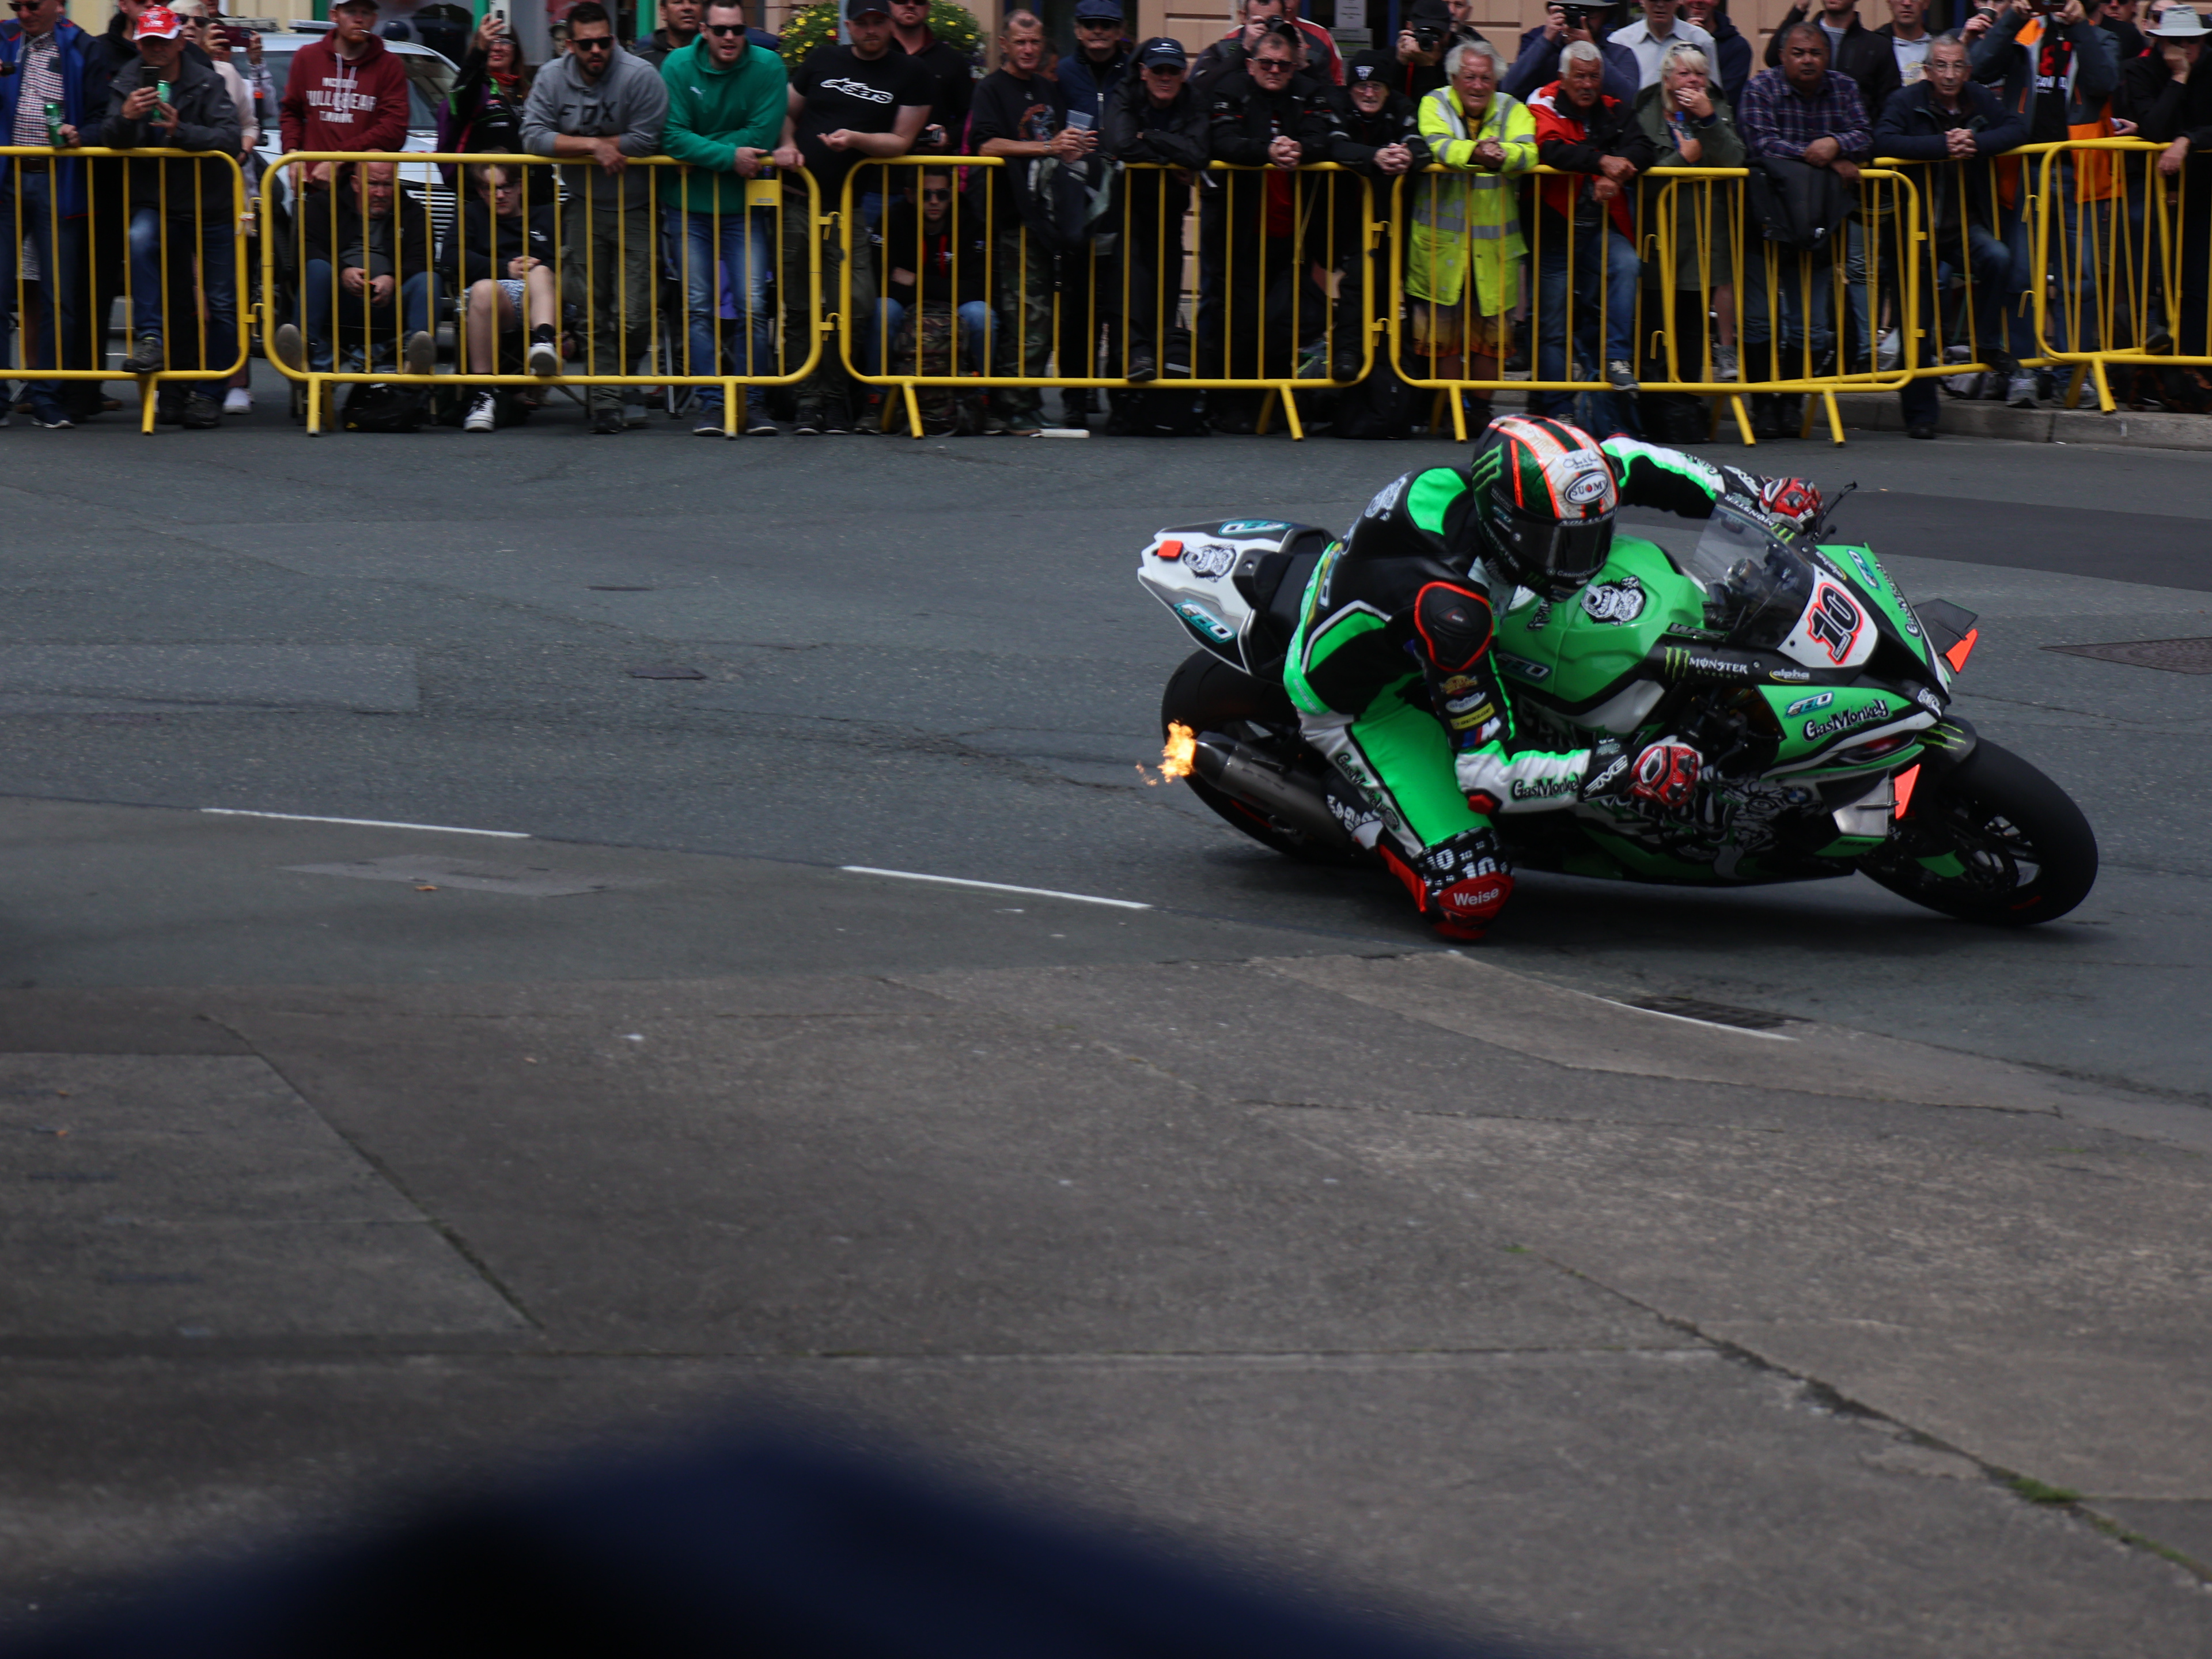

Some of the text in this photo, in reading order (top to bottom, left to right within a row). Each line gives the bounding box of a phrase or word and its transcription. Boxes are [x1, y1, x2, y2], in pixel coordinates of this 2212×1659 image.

[559, 101, 618, 126] FOX
[1570, 480, 1608, 497] SUOMY
[1808, 584, 1862, 662] 10
[1689, 657, 1748, 675] MONSTER
[1772, 668, 1810, 679] alpha
[1461, 856, 1498, 880] 10
[1453, 887, 1500, 907] Weise
